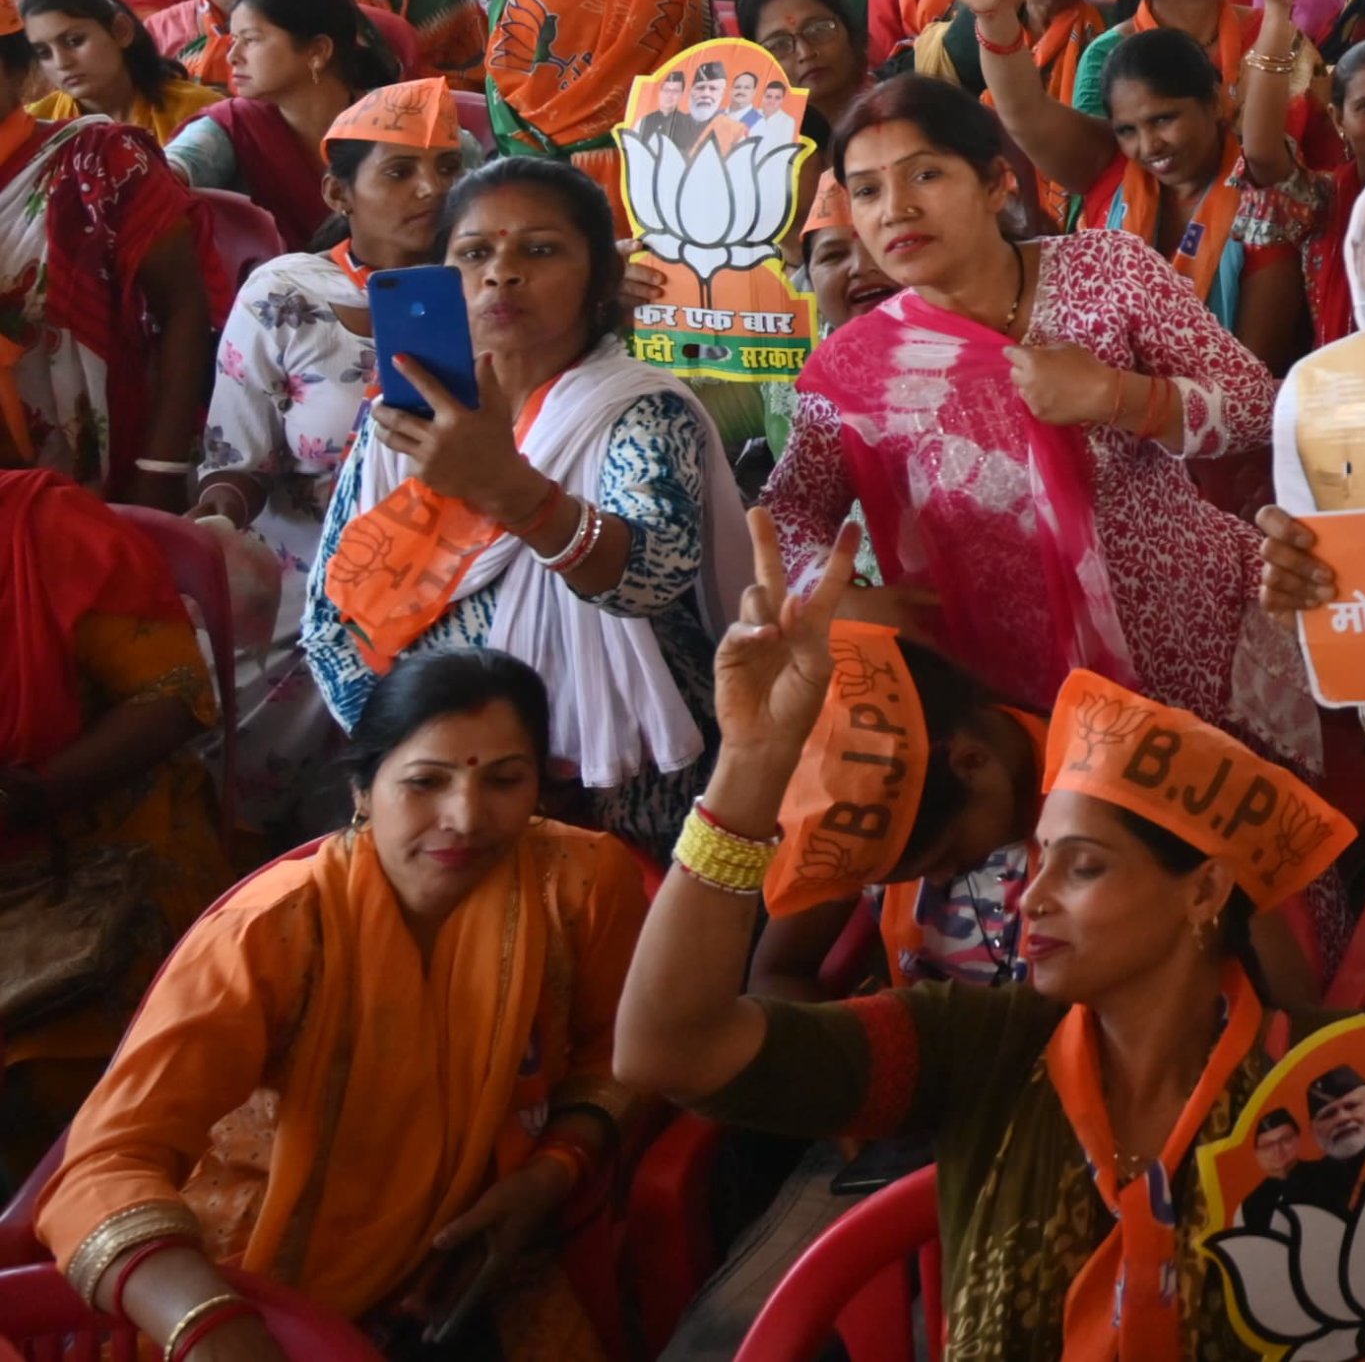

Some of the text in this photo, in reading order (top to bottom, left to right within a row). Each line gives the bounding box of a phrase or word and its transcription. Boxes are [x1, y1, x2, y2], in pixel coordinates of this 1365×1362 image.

[681, 306, 735, 331] एक
[739, 311, 795, 334] बार
[738, 346, 806, 369] सरकार
